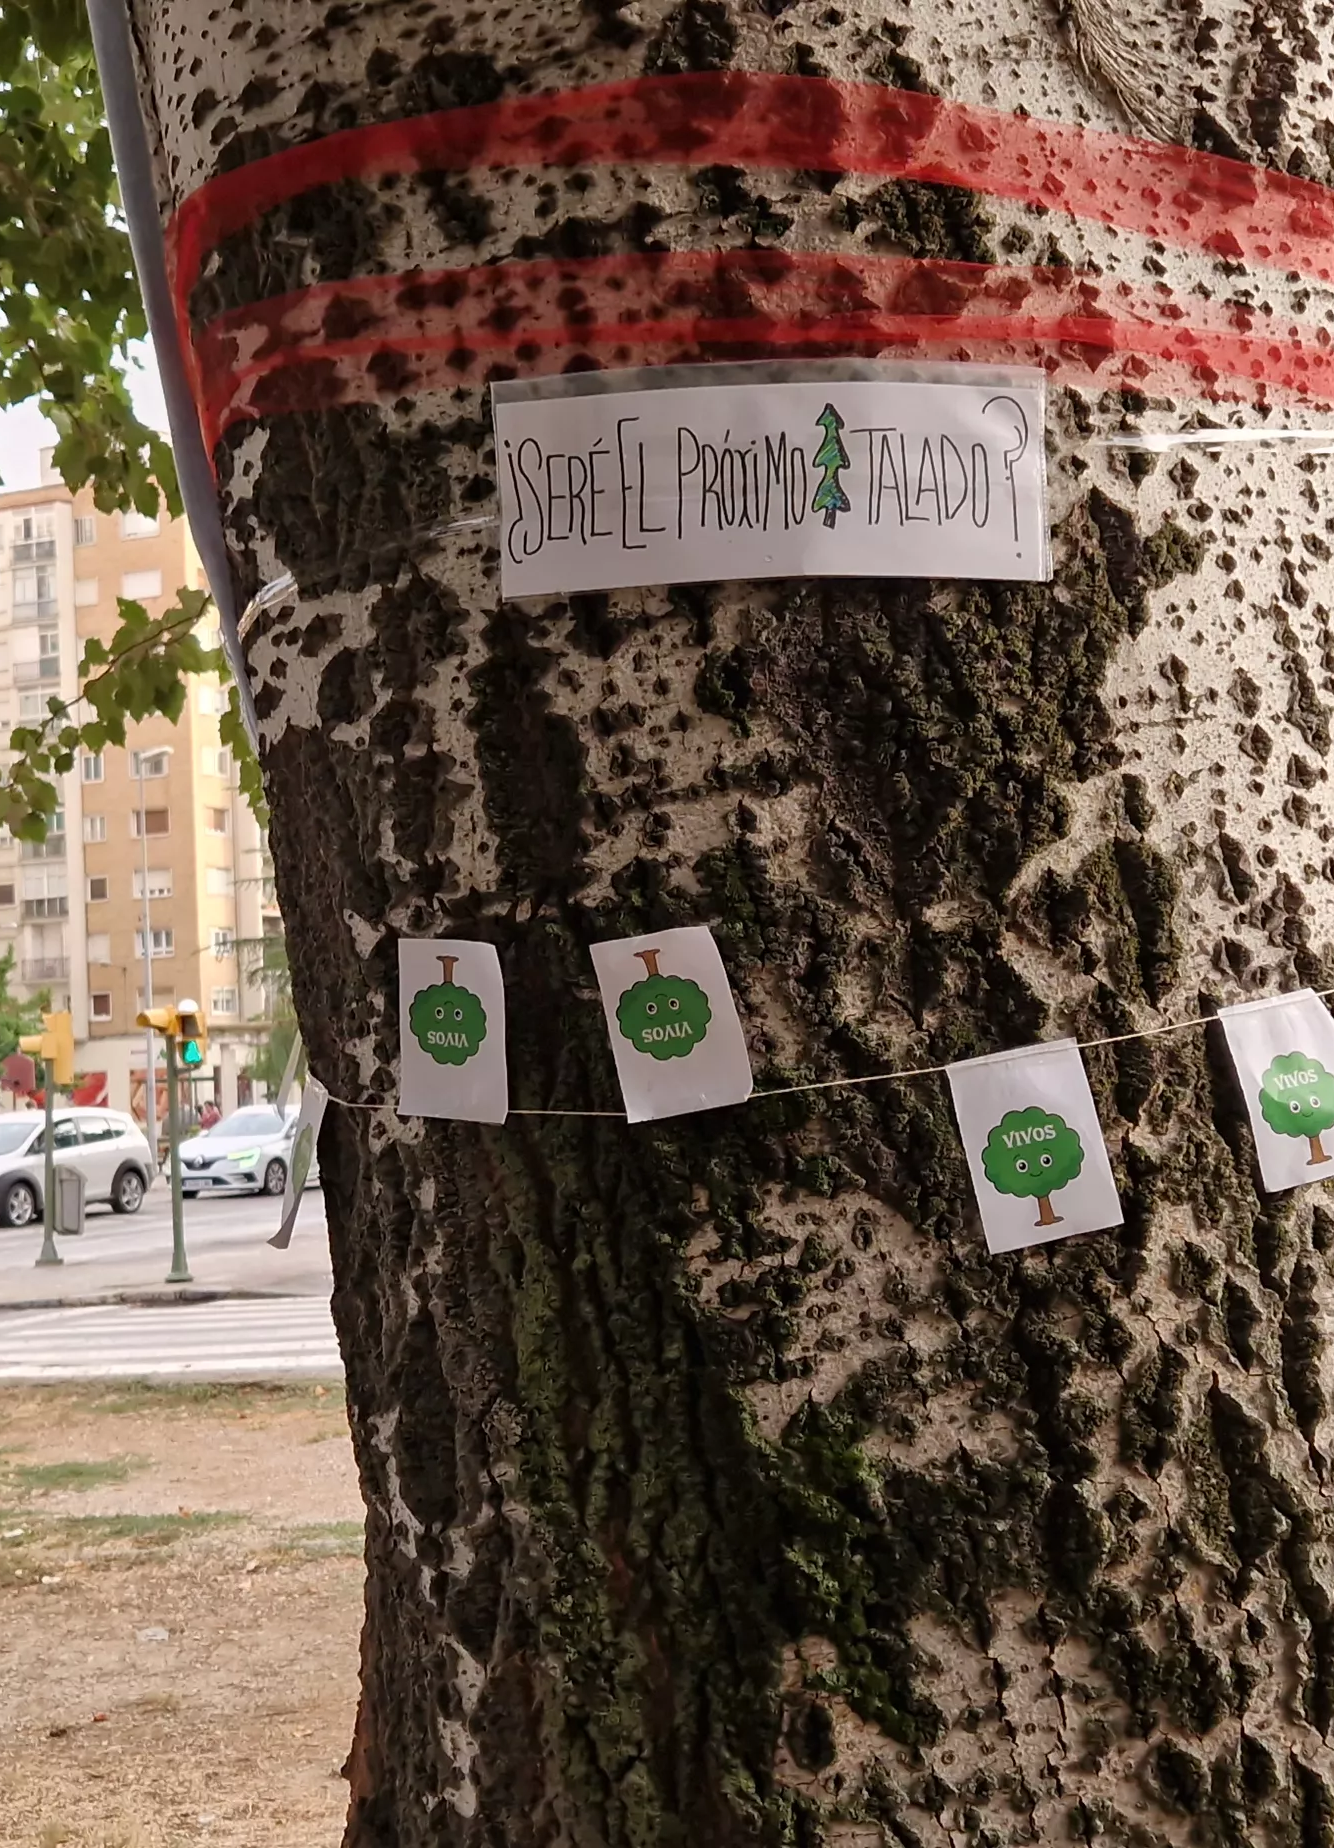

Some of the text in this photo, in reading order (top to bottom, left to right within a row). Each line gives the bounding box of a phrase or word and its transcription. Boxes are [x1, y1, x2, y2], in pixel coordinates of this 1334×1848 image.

[616, 417, 667, 550] EL
[849, 395, 1029, 559] TALADO?
[427, 1030, 469, 1048] VIVOS
[642, 1021, 694, 1043] VIVOS
[1272, 1068, 1319, 1091] VIVOS
[1002, 1124, 1057, 1149] VIVOS
